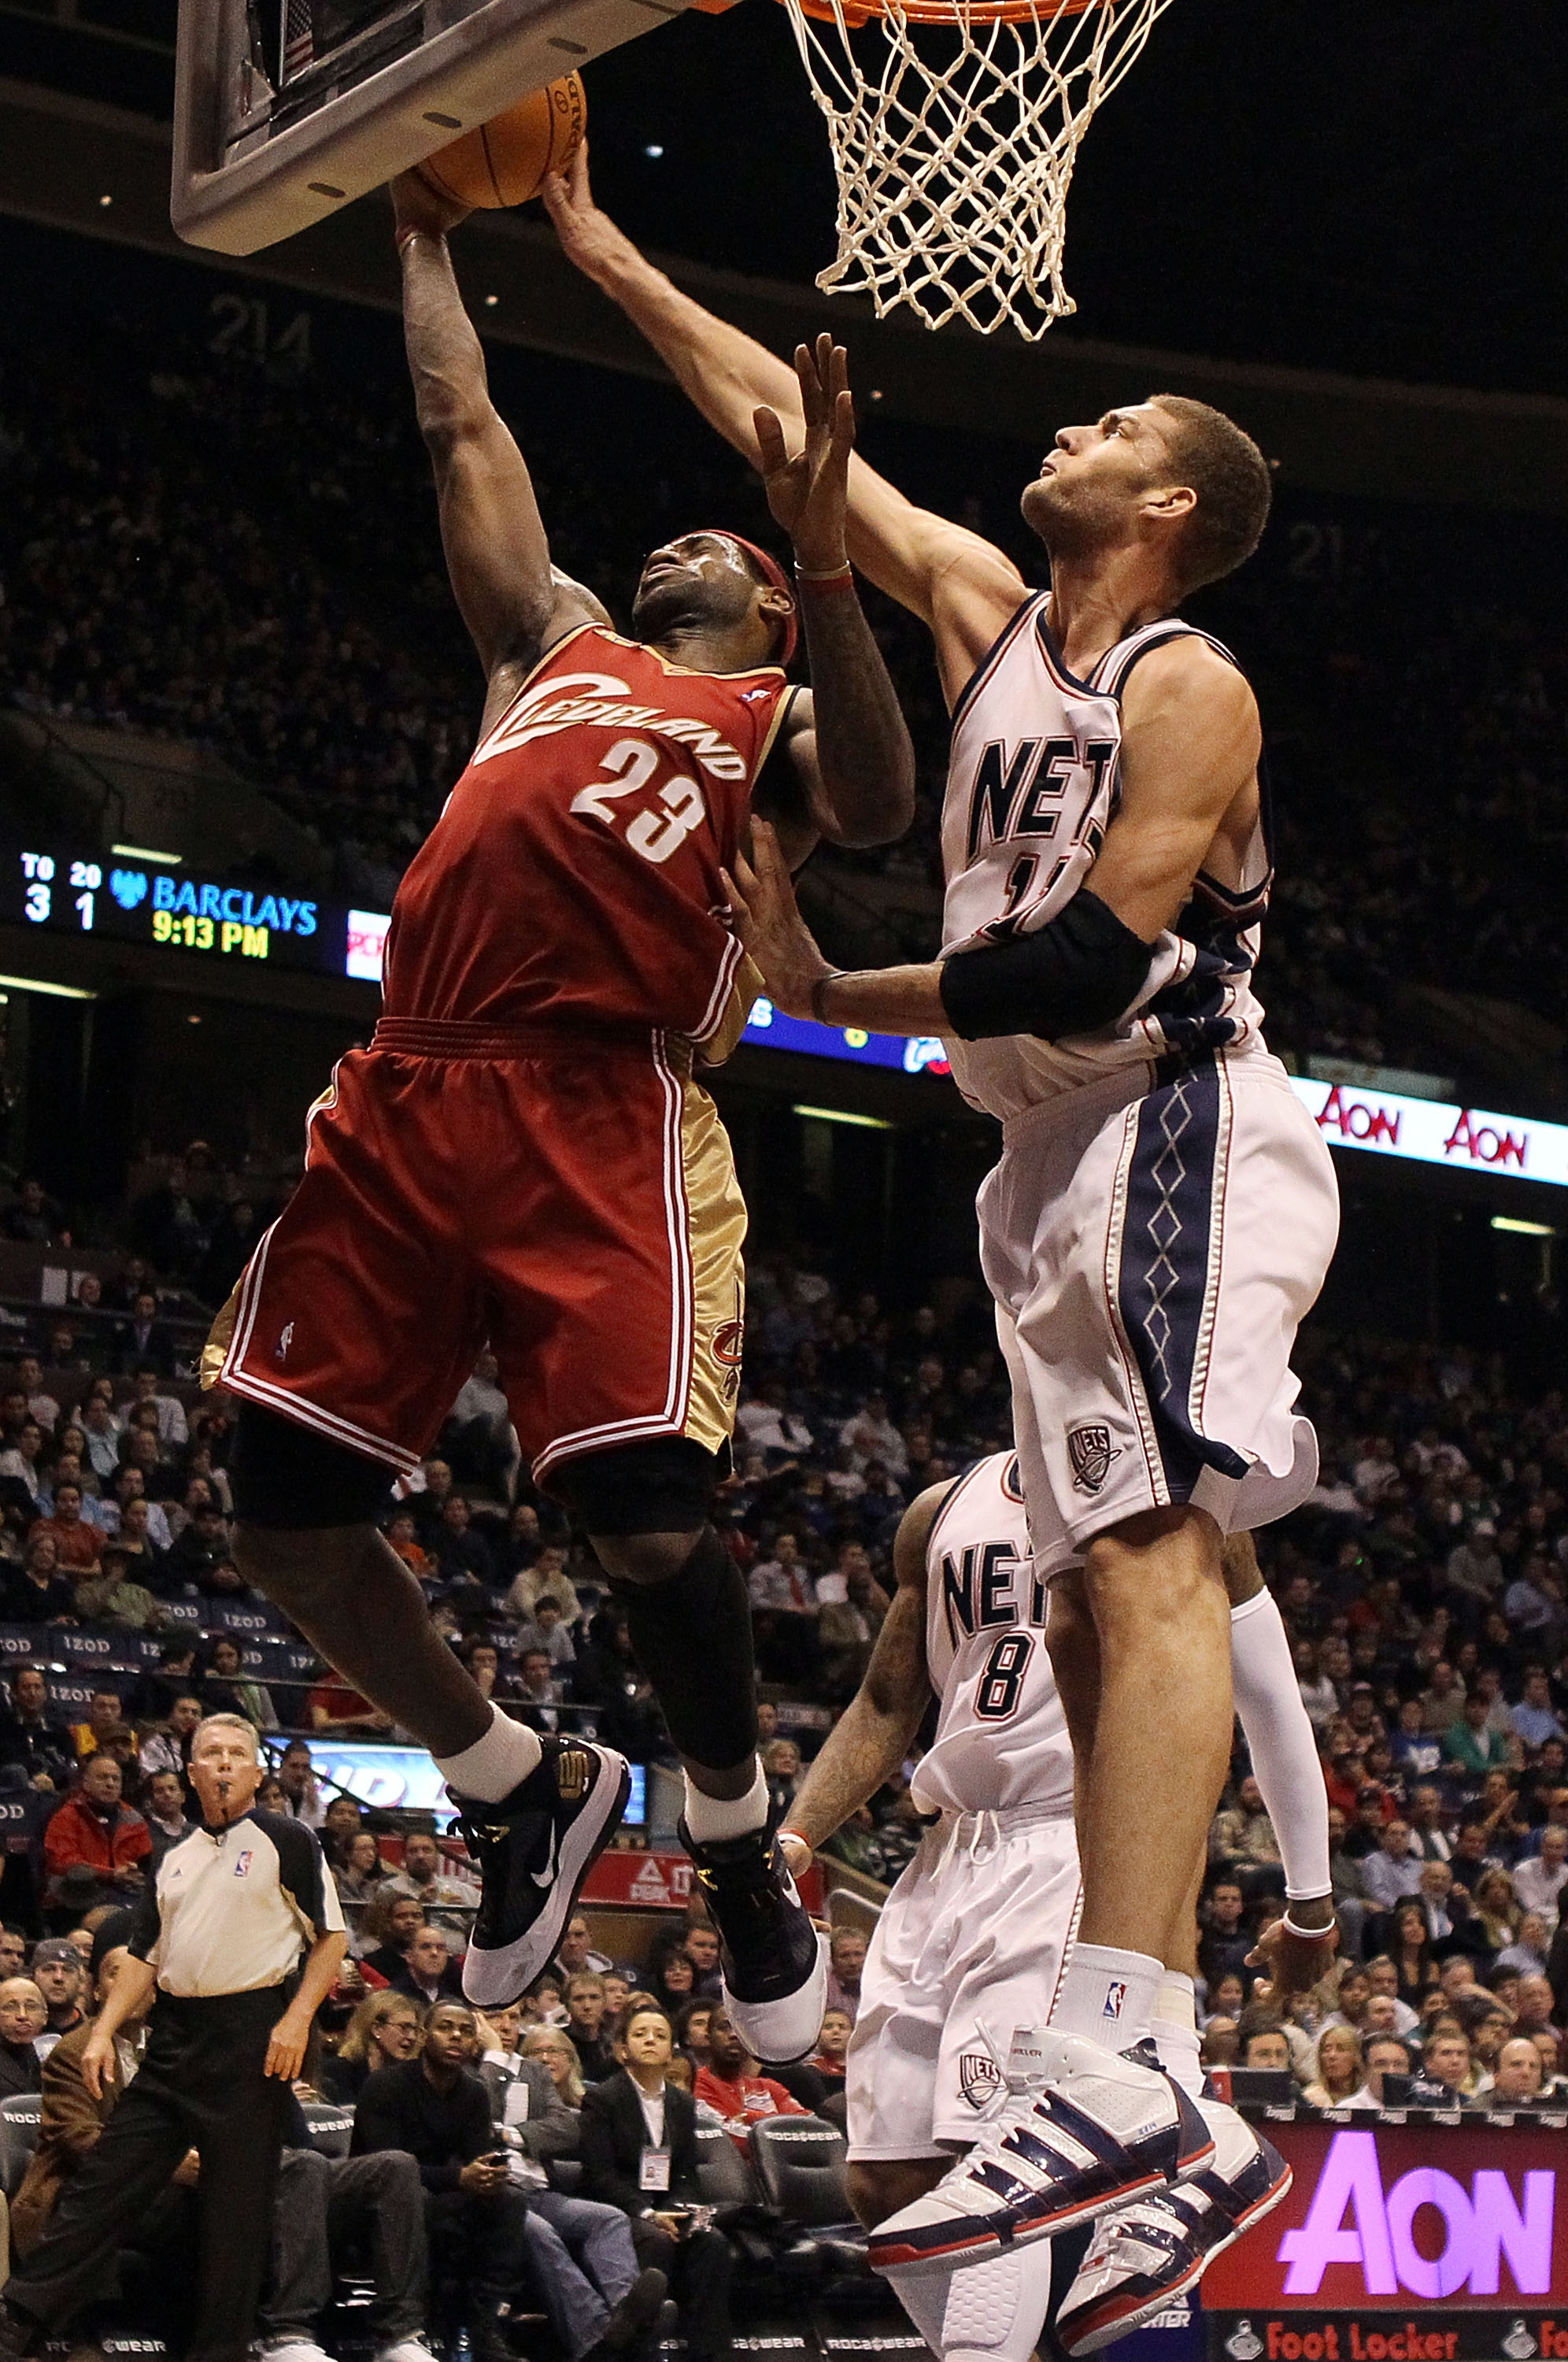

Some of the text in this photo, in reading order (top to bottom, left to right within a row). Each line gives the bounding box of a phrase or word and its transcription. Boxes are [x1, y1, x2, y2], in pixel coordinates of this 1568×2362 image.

[570, 738, 707, 863] 23
[967, 736, 1119, 870] NET
[20, 853, 55, 880] TO
[70, 861, 102, 889] 20
[24, 883, 51, 922] 3
[76, 892, 94, 930] 1
[152, 876, 317, 935] BARCLAYS
[152, 911, 268, 958] 9:13 PM
[1315, 1086, 1403, 1146] AON
[1444, 1109, 1530, 1168] AON
[941, 1540, 1048, 1655] NET
[224, 1614, 267, 1628] IZOD
[0, 1638, 31, 1653] OD
[64, 1636, 110, 1653] IZOD
[973, 1630, 1036, 1721] 8
[0, 1804, 25, 1820] OD
[1276, 2131, 1556, 2299] AON
[1267, 2321, 1459, 2360] Foot Locker
